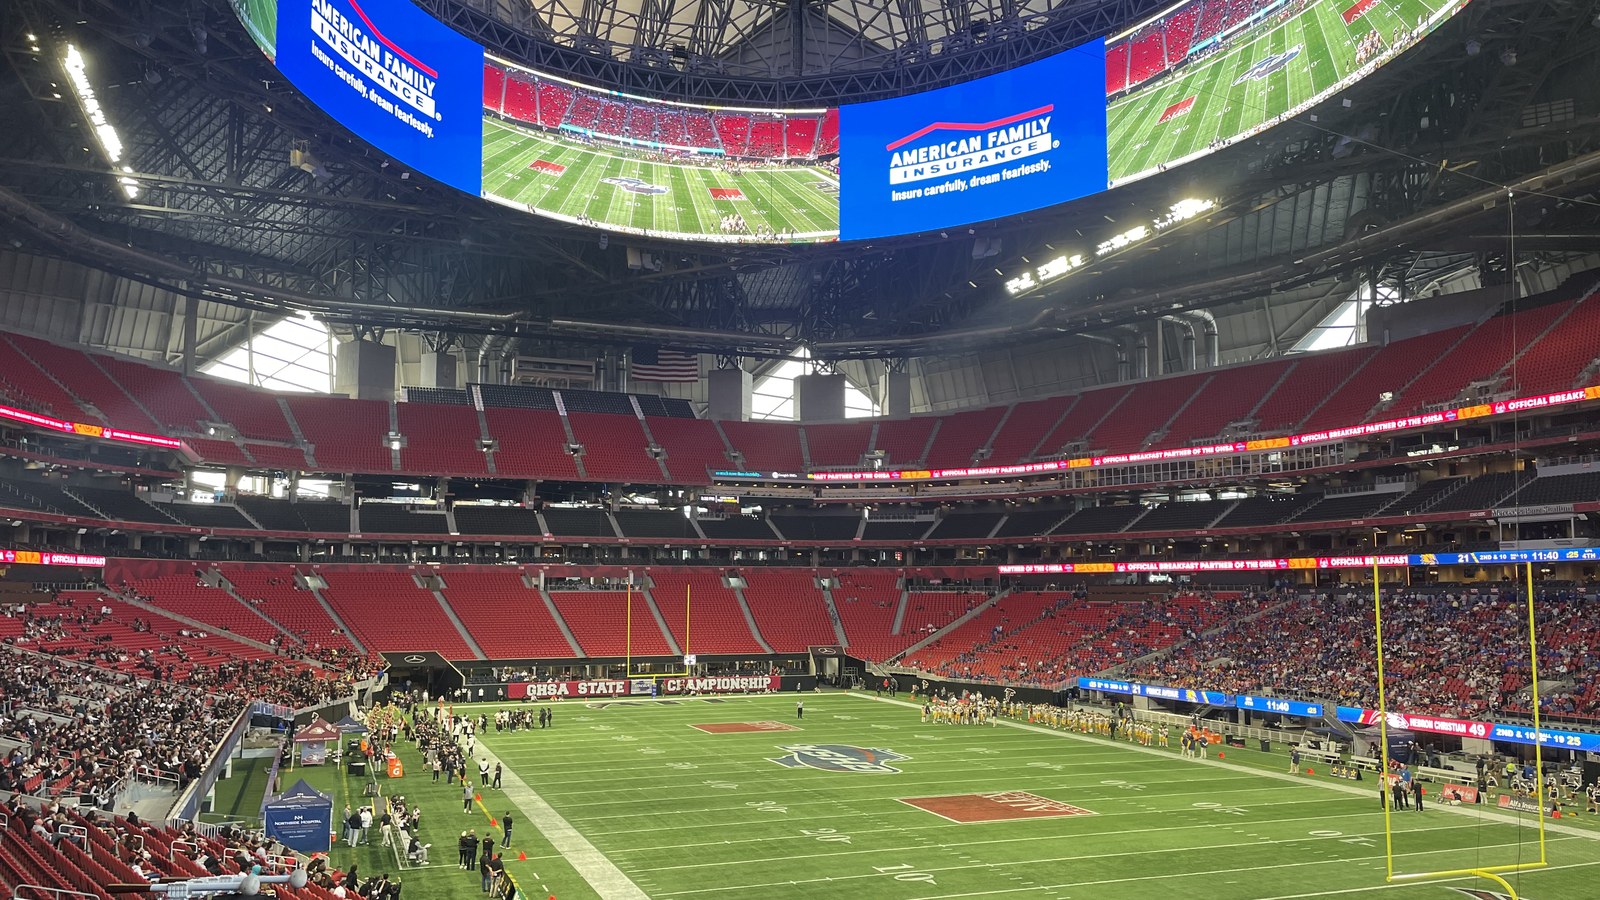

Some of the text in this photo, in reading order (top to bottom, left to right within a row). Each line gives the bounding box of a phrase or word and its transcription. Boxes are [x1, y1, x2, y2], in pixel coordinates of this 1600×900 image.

[312, 0, 436, 96] AMERICAN FAMILY
[320, 22, 424, 107] INSURANCE
[312, 40, 434, 138] Insure carefully, dream fearlessly.
[890, 116, 1051, 168] AMERICAN FAMILY
[903, 141, 1038, 179] INSURANCE
[892, 159, 1051, 202] Insure carefully, dream fearlessly.
[1509, 391, 1585, 410] OFFICIAL BREAKF
[1301, 414, 1443, 443] OFFICIAL BREAKFAST PARTNER OF THE GHSA
[1102, 455, 1128, 464] OFFICIAL
[1129, 452, 1162, 461] BREAKFAST
[1164, 449, 1191, 458] PARTNER
[1215, 445, 1233, 453] GHSA
[942, 469, 967, 477] OFFICIAL
[968, 467, 1000, 475] BREAKFAST
[1001, 465, 1025, 474] PARTNER
[1026, 464, 1033, 472] OF
[51, 554, 76, 565] OFFICIAL
[1331, 557, 1364, 567] OFFICIAL
[1458, 554, 1469, 563] 21
[1532, 552, 1558, 561] 11:40
[1128, 563, 1158, 571] OFFICIAL
[1159, 562, 1198, 570] BREAKFAST
[1200, 561, 1233, 570] PARTNER
[1234, 561, 1244, 569] OF
[1259, 560, 1276, 568] GHSA
[526, 683, 569, 696] GHSA
[577, 681, 624, 694] STATE
[1132, 684, 1140, 694] 21
[1267, 700, 1289, 712] 11:40
[1409, 717, 1485, 737] HEBRON CHRISTIAN 49
[1496, 728, 1535, 740] 2ND & 10
[1553, 735, 1564, 743] 19
[1567, 736, 1581, 746] 25
[393, 767, 400, 775] G
[1509, 799, 1521, 808] Alfa
[1522, 802, 1551, 812] Insurace
[800, 828, 851, 844] 20
[872, 863, 937, 885] 10
